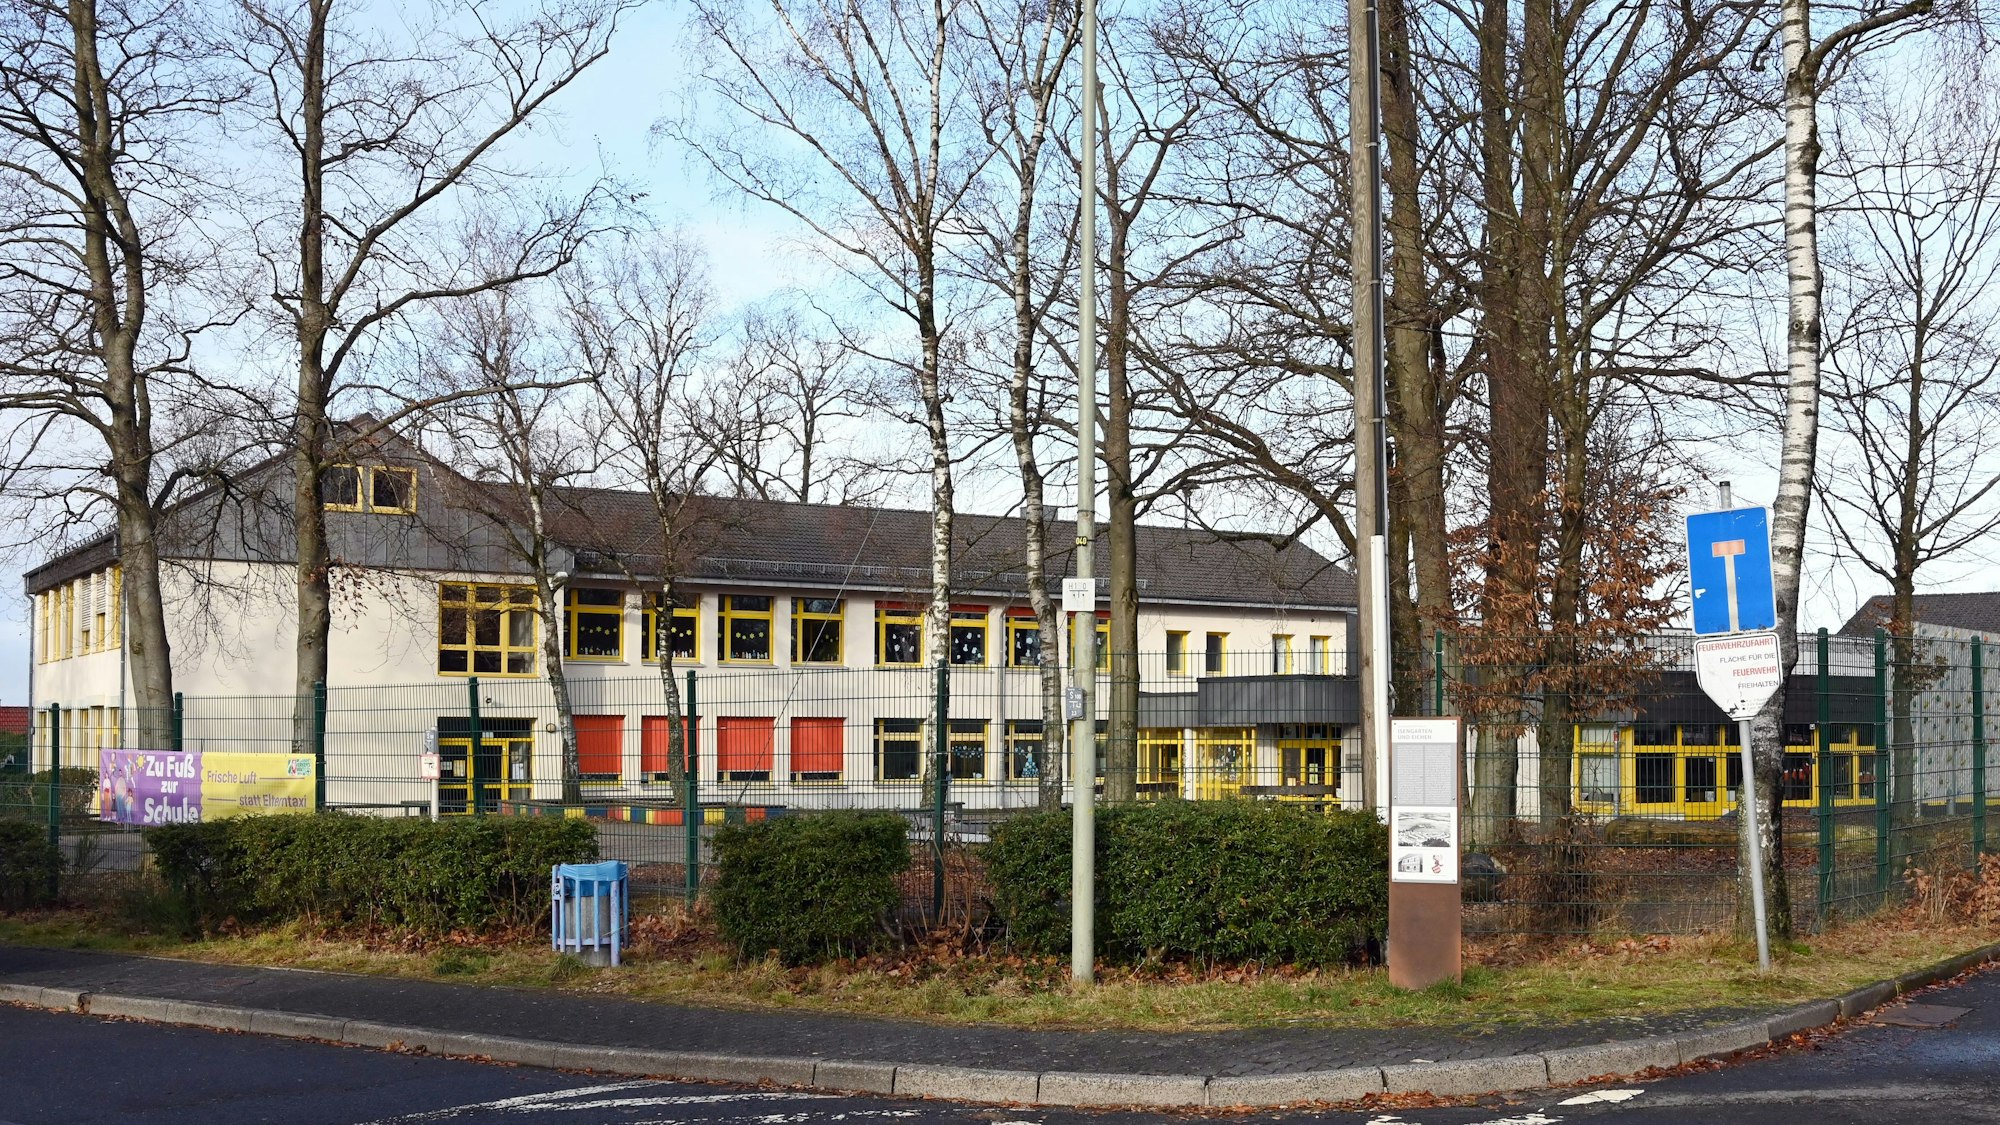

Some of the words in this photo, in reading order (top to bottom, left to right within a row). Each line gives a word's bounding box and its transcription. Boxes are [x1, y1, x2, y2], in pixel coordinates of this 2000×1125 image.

[1698, 637, 1774, 652] FEUERWEHRZUFAHRT
[1748, 653, 1762, 661] FÜR
[1732, 665, 1777, 677] FEUERWEHR
[1737, 680, 1779, 689] FREIHALTEN
[146, 755, 165, 778] Zu
[166, 753, 196, 779] Fuß
[207, 770, 238, 784] Frische
[239, 771, 257, 785] Luft
[160, 780, 179, 794] zur
[239, 795, 261, 808] statt
[262, 794, 307, 808] Elterntaxi
[143, 795, 199, 824] Schule
